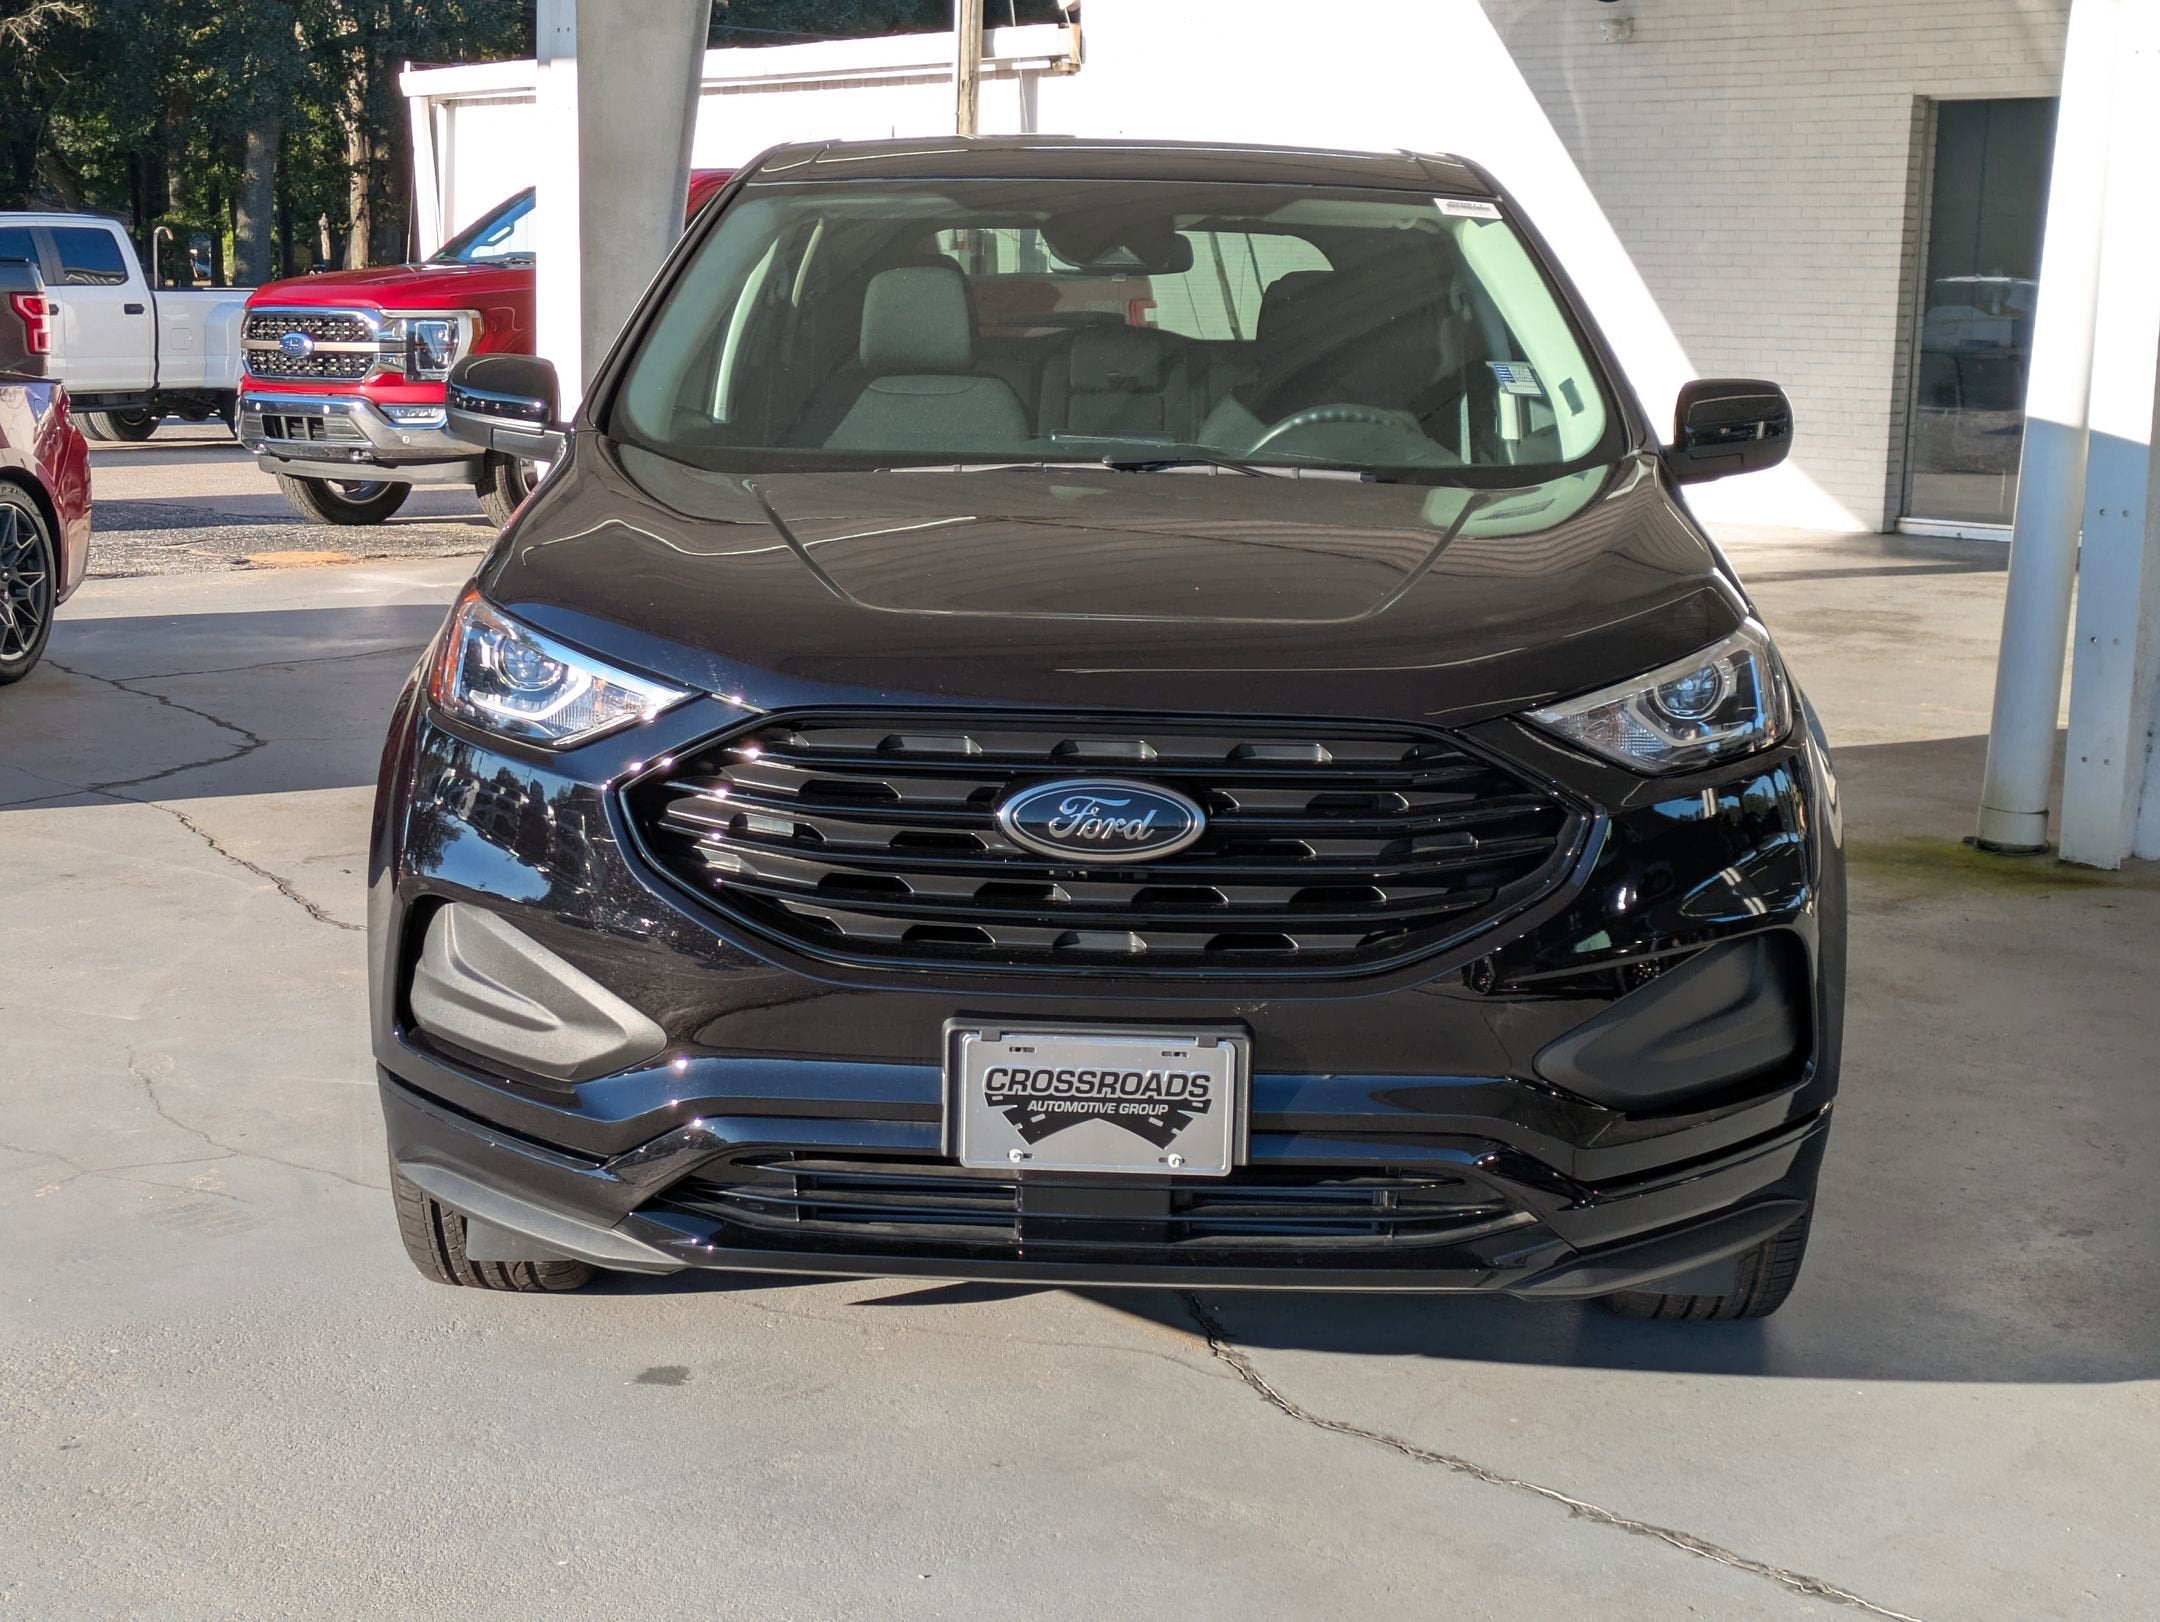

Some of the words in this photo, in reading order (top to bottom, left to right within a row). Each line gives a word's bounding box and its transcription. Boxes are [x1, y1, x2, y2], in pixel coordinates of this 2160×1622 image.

[1048, 795, 1159, 841] Ford
[985, 1067, 1211, 1099] CROSSROADS
[1027, 1100, 1117, 1114] AUTOMOTIVE
[1118, 1102, 1169, 1116] GROUP
